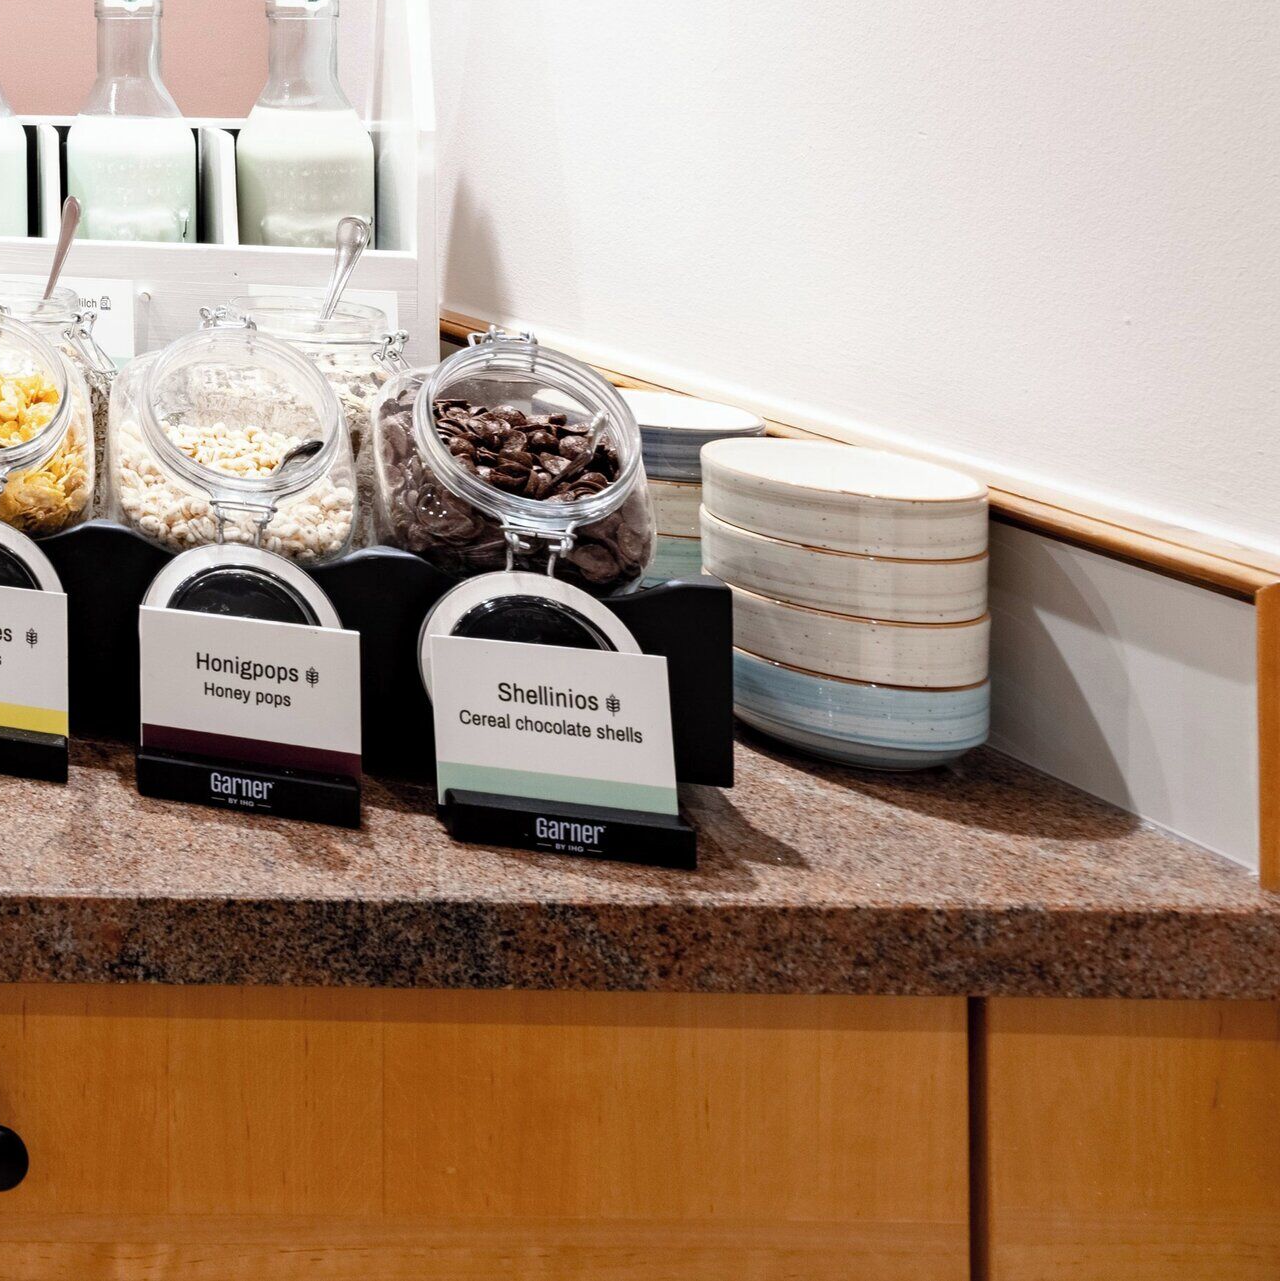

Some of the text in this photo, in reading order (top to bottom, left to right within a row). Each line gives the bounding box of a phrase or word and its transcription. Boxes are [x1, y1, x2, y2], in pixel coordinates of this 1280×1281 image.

[196, 652, 299, 684] Honigpops
[204, 681, 291, 708] Honey pops
[498, 682, 599, 711] Shellinios
[459, 709, 643, 744] Cereal chocolate shells
[210, 772, 273, 800] Garner
[536, 817, 604, 845] Garner
